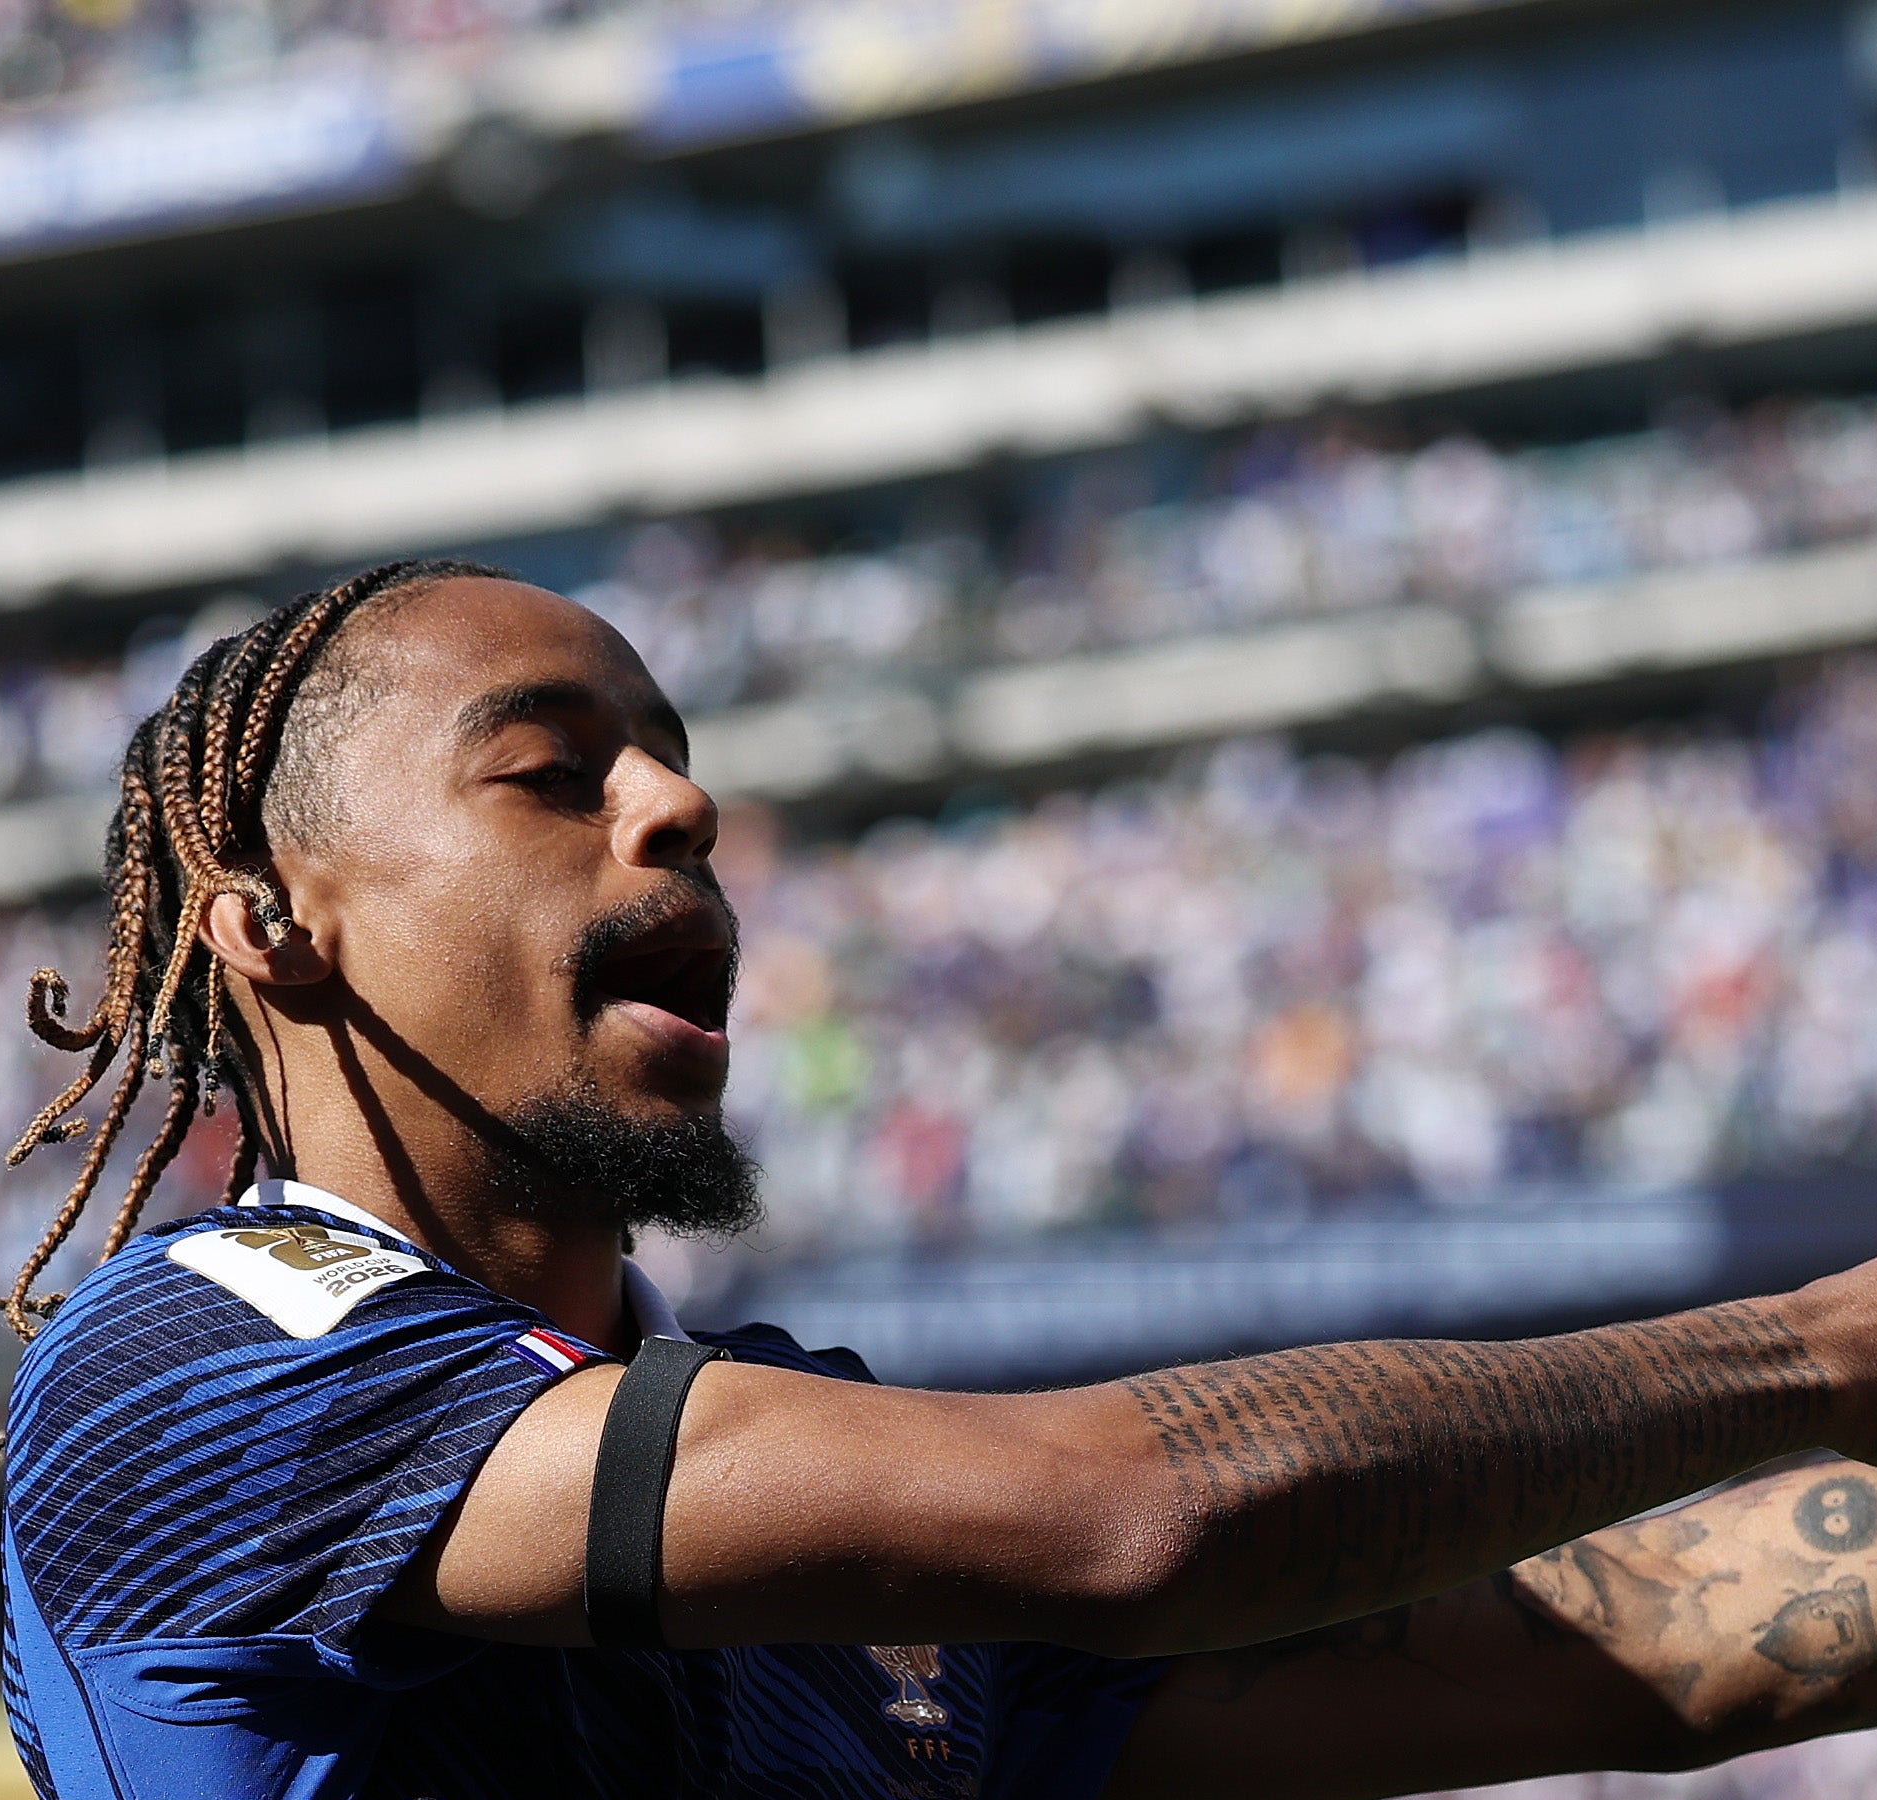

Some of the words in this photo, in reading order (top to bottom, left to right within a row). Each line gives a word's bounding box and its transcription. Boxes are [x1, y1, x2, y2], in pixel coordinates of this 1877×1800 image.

[310, 1248, 353, 1262] FIFA
[313, 1262, 364, 1284] WORLD
[365, 1257, 392, 1266] CUP
[325, 1264, 409, 1298] 2026
[905, 1738, 951, 1761] FFF
